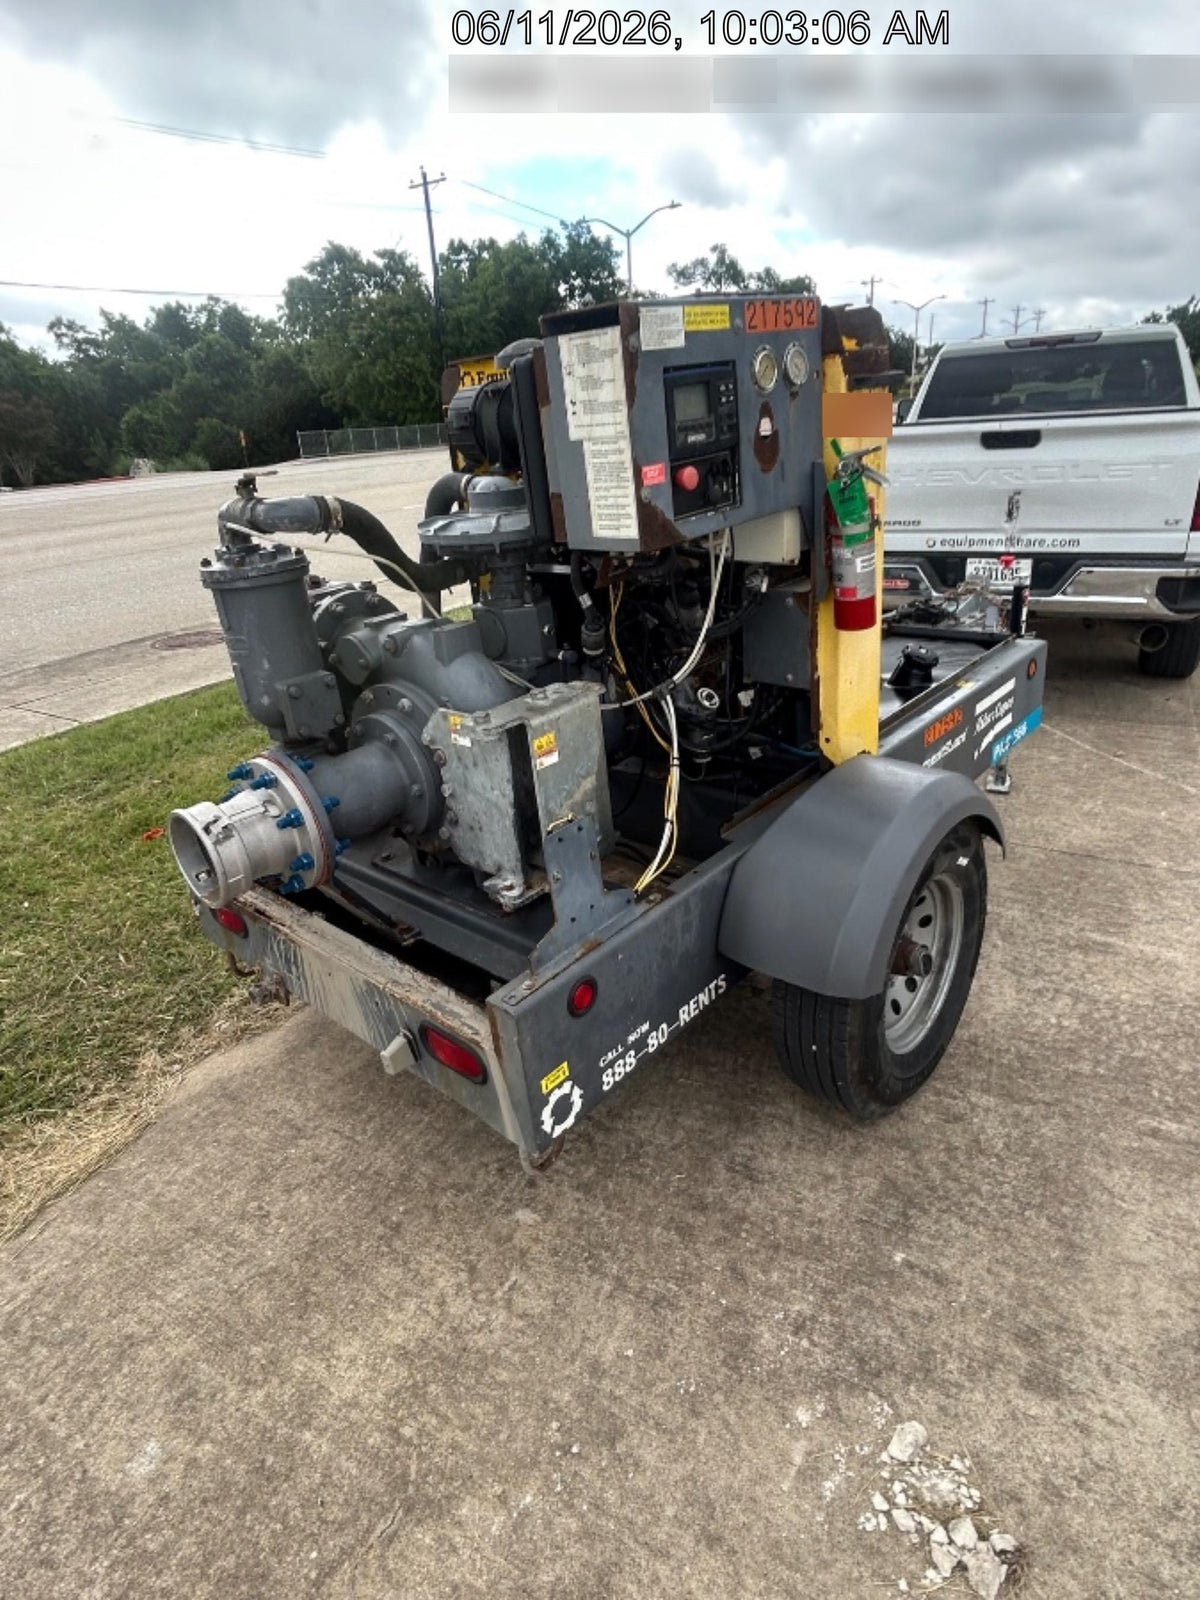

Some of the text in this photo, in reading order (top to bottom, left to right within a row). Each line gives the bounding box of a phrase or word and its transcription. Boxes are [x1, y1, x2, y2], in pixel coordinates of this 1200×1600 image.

[748, 301, 818, 330] 217592
[882, 463, 1176, 488] HEVROLET
[599, 1020, 650, 1067] CALL NOW
